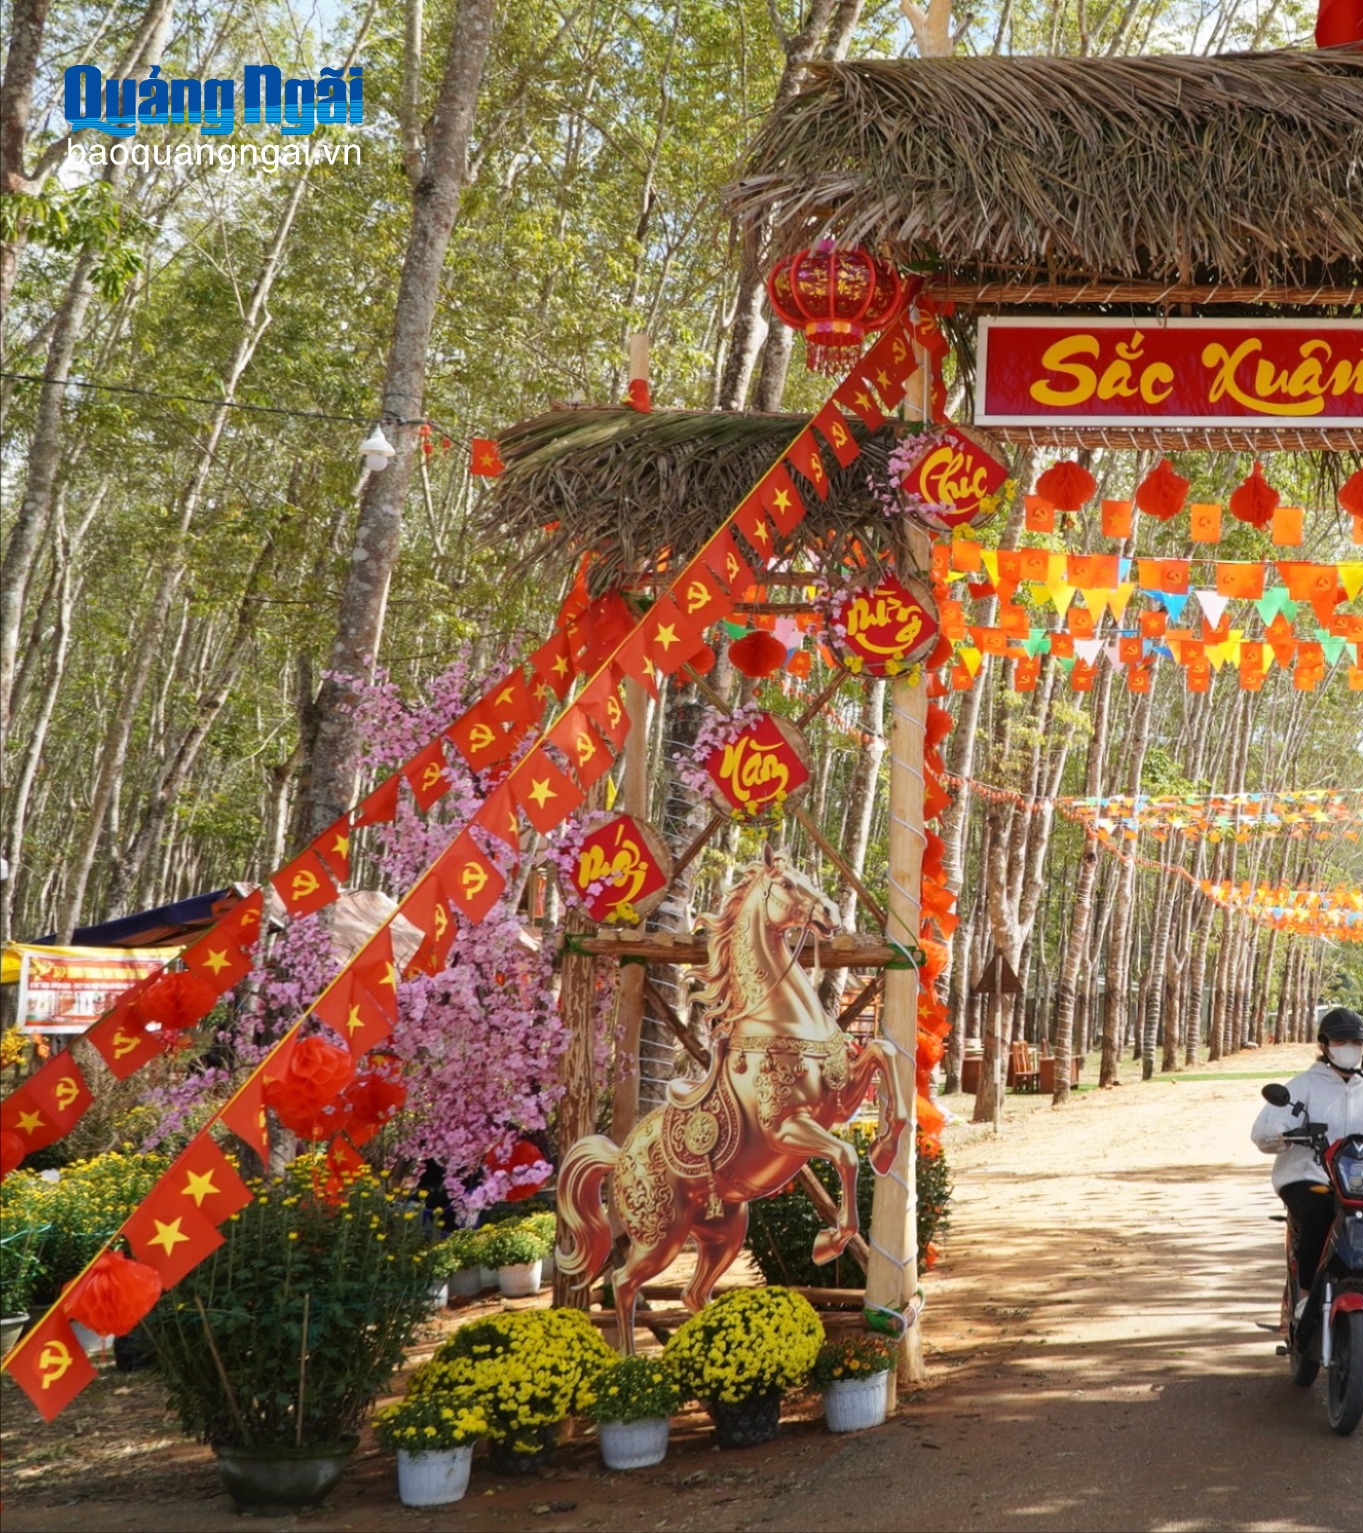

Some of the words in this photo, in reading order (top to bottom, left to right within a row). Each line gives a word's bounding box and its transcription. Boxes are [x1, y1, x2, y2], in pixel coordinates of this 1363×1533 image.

[1029, 330, 1175, 407] Sắc
[919, 446, 988, 515] Chúc
[718, 735, 790, 803] Năm
[577, 823, 650, 907] Mới
